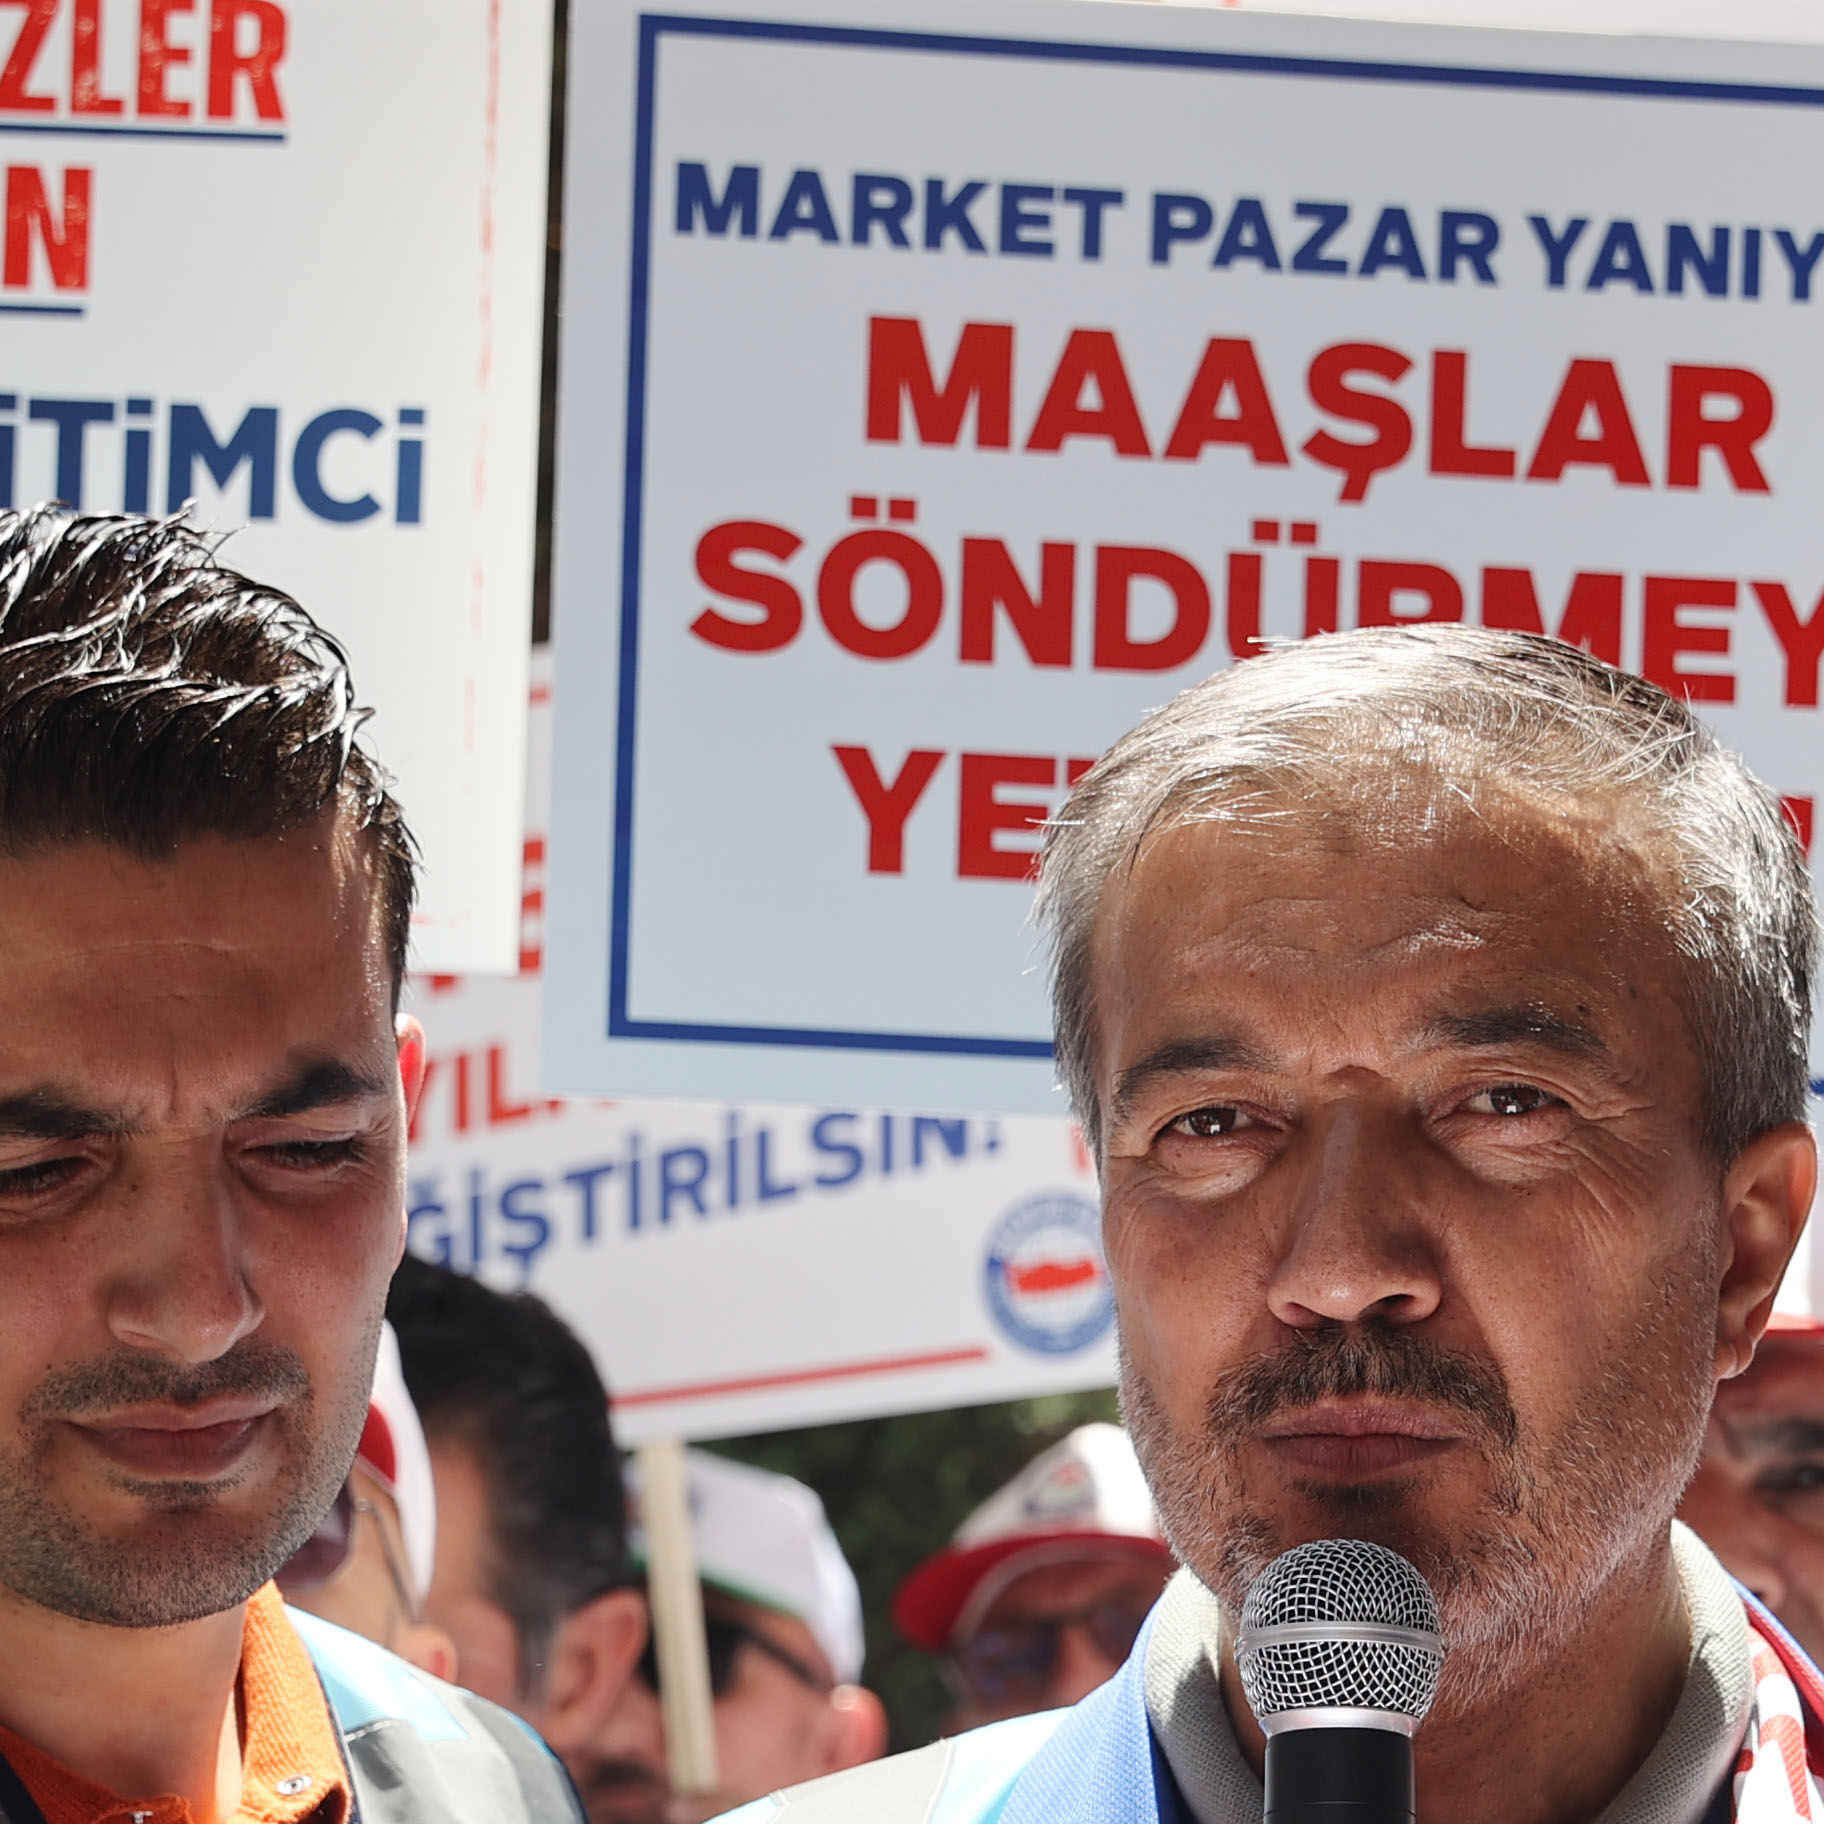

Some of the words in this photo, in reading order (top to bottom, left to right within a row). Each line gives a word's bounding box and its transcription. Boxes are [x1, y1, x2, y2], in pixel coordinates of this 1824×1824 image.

[672, 160, 1127, 260] MARKET
[1149, 193, 1501, 286] PAZAR
[864, 314, 1777, 505] MAAŞLAR
